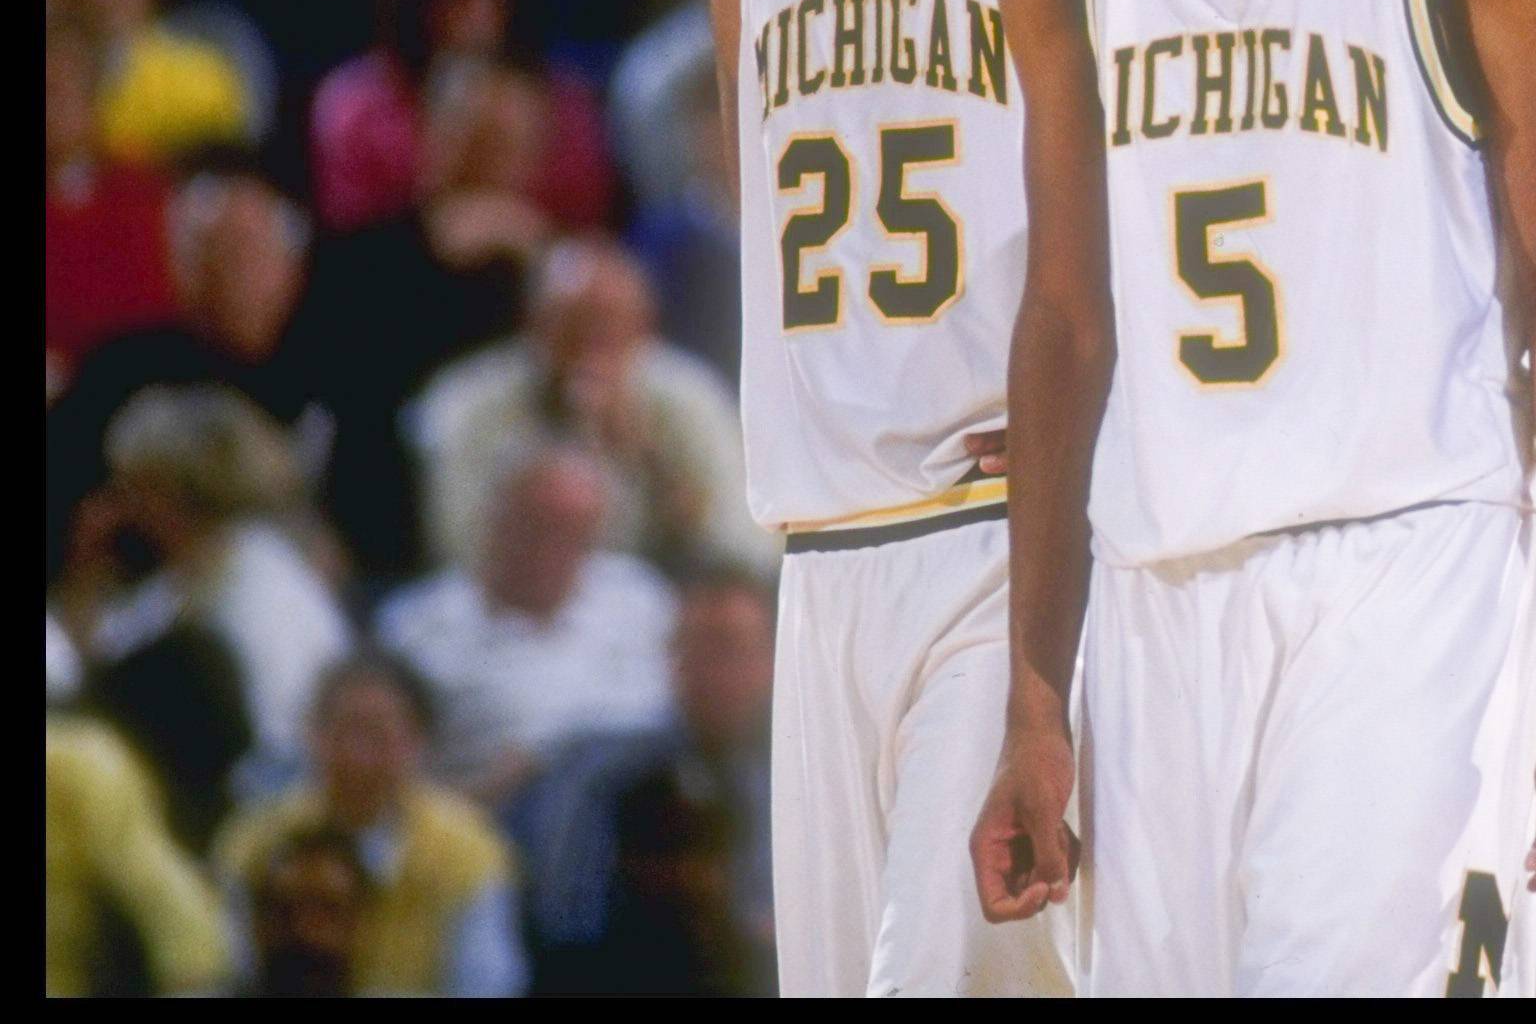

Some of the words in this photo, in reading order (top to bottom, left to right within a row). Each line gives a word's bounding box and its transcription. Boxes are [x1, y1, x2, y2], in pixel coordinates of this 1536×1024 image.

[1110, 28, 1388, 153] ICHIGAN
[776, 120, 963, 331] 25
[1170, 178, 1281, 386] 5
